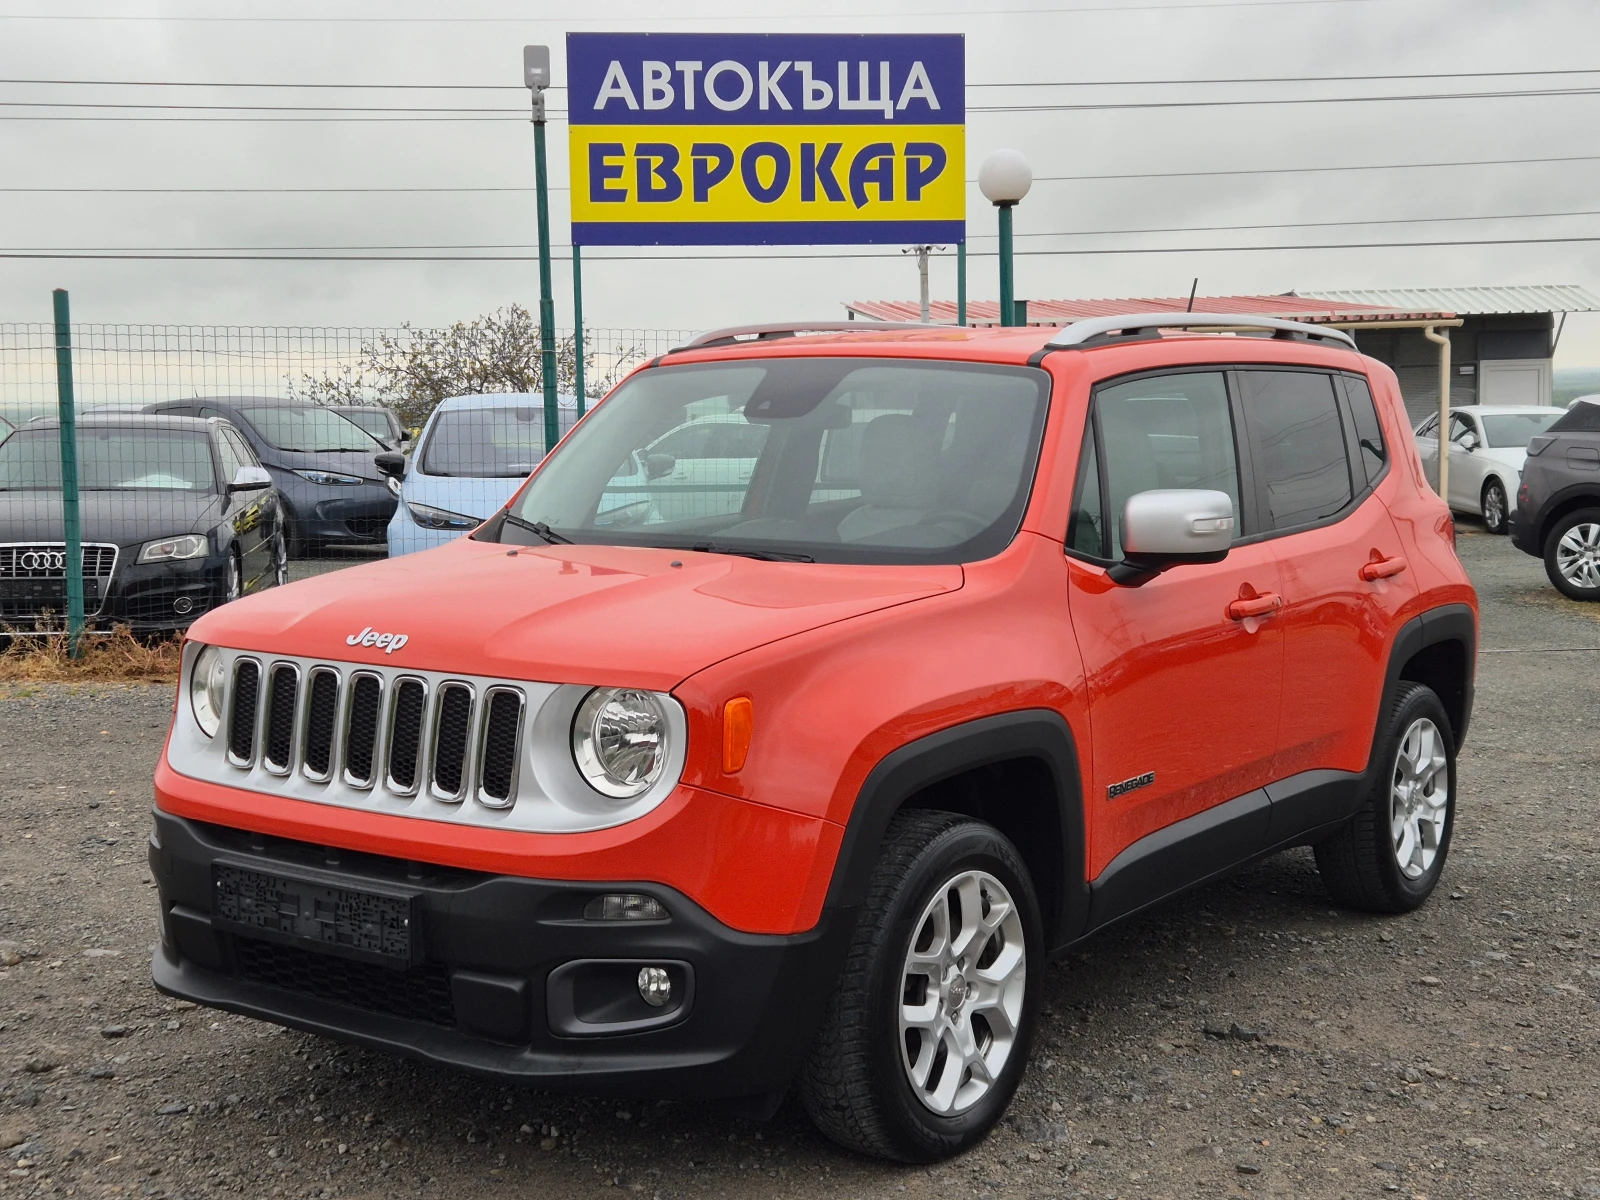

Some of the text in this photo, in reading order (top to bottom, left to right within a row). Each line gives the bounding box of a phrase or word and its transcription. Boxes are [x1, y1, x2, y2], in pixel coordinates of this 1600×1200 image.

[593, 59, 941, 120] АВТОКЪЩА
[588, 141, 947, 210] ЕВРОКАР
[346, 627, 409, 654] Jeep
[1107, 771, 1155, 800] RENEGADE
